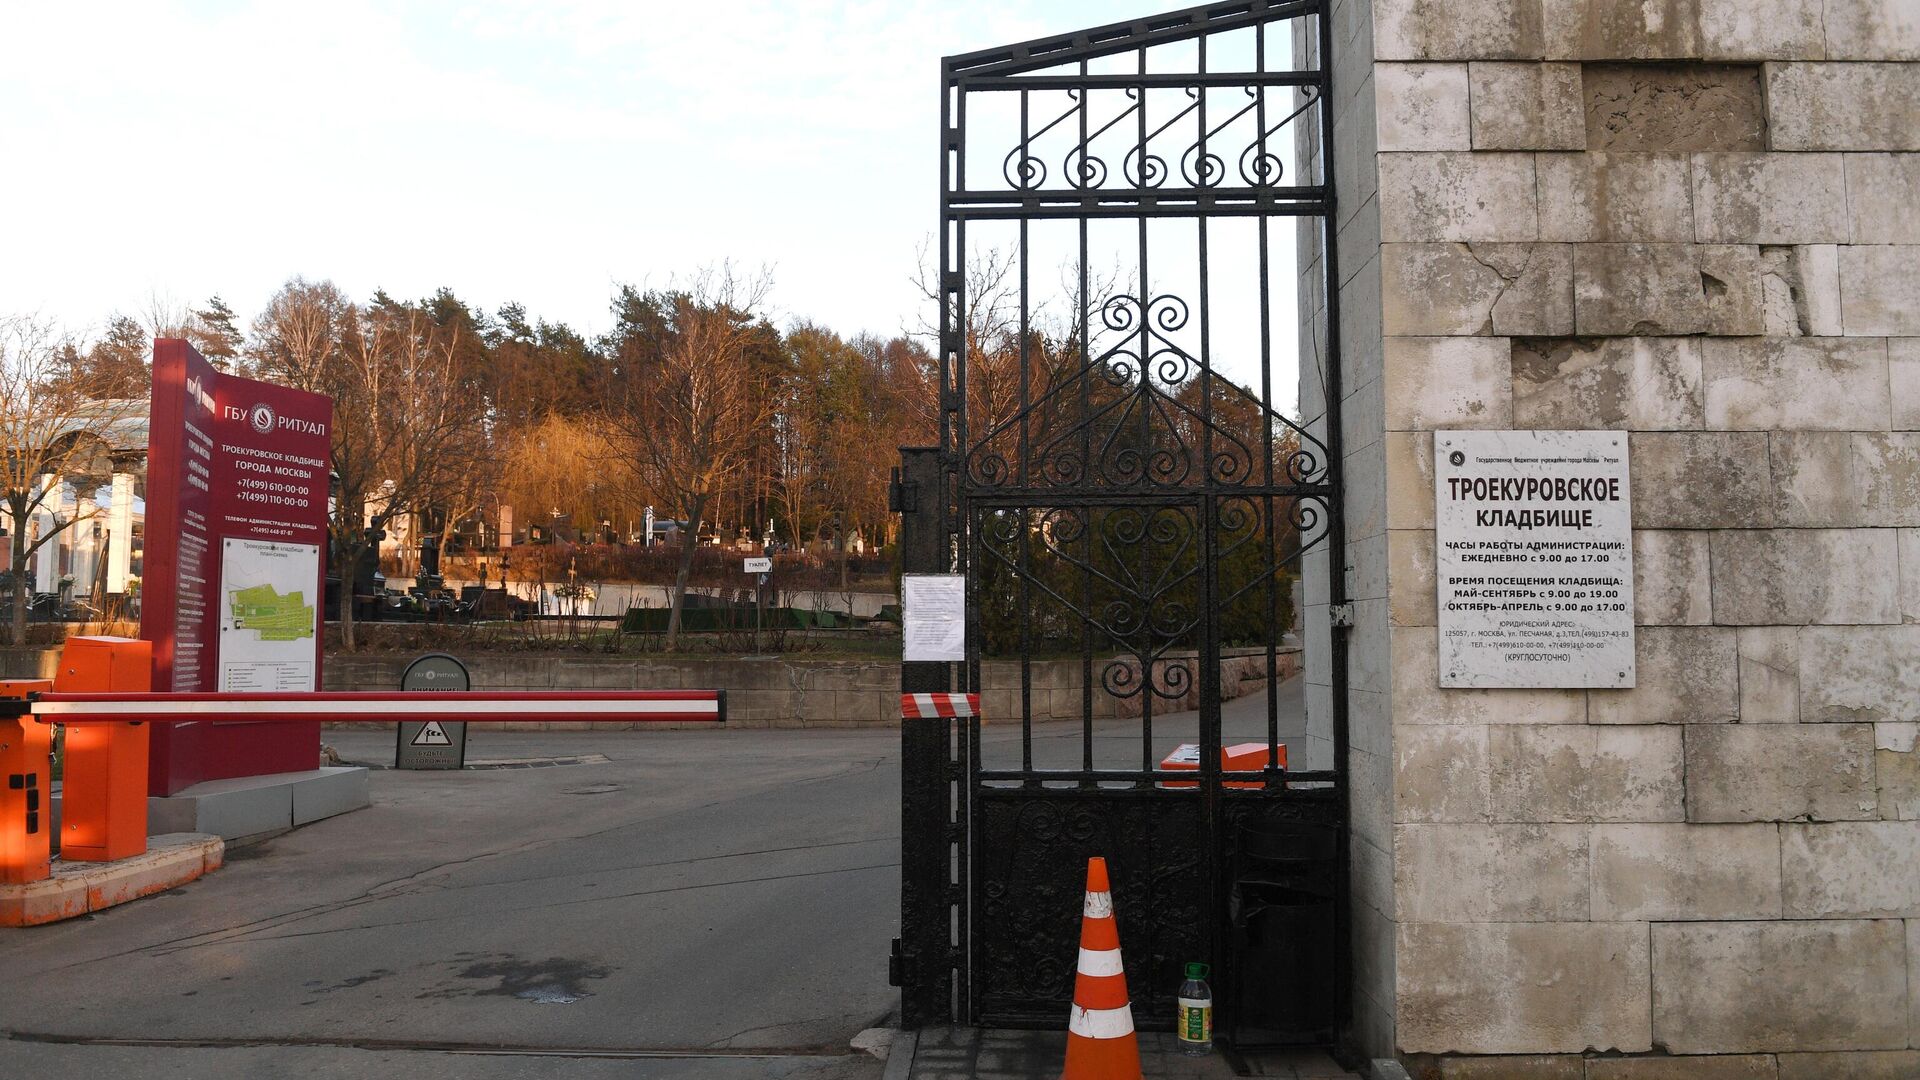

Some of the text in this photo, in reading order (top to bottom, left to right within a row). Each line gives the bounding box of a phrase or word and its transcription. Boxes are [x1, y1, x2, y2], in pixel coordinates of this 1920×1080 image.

[224, 406, 325, 436] ГБУ РИТУАЛ
[222, 444, 283, 461] ТРОЕКУРОВСКОЕ
[285, 454, 325, 468] КЛАДБИЩЕ
[235, 461, 312, 479] ГОРОДА МОСКВЫ
[269, 482, 309, 495] 610-00-00
[1448, 477, 1620, 501] ТРОЕКУРОВСКОЕ
[269, 495, 309, 508] 110-00-00
[249, 518, 291, 527] АДМИНИСТРАЦИИ
[291, 522, 317, 530] КЛАДБИЩА
[1476, 509, 1592, 530] КЛАДБИЩЕ
[1445, 542, 1625, 551] ЧАСЫ РАБОТЫ АДМИНИСТРАЦИИ:
[1461, 555, 1528, 563] ЕЖЕДНЕВНО
[1539, 555, 1562, 563] 9.00
[1581, 555, 1610, 563] 17.00
[1449, 578, 1624, 587] ВРЕМЯ ПОСЕЩЕНИЯ КЛАДБИЩА:
[1454, 588, 1536, 598] МАЙ-СЕНТЯБРЬ
[1547, 590, 1571, 598] 9.00
[1590, 590, 1618, 598] 19.00
[1448, 603, 1543, 612] ОКТЯБРЬ-АПРЕЛЬ
[1499, 620, 1550, 628] ЮРИДИЧЕСКИЙ
[1504, 653, 1571, 663] (КРУГЛОСУТОЧНО)
